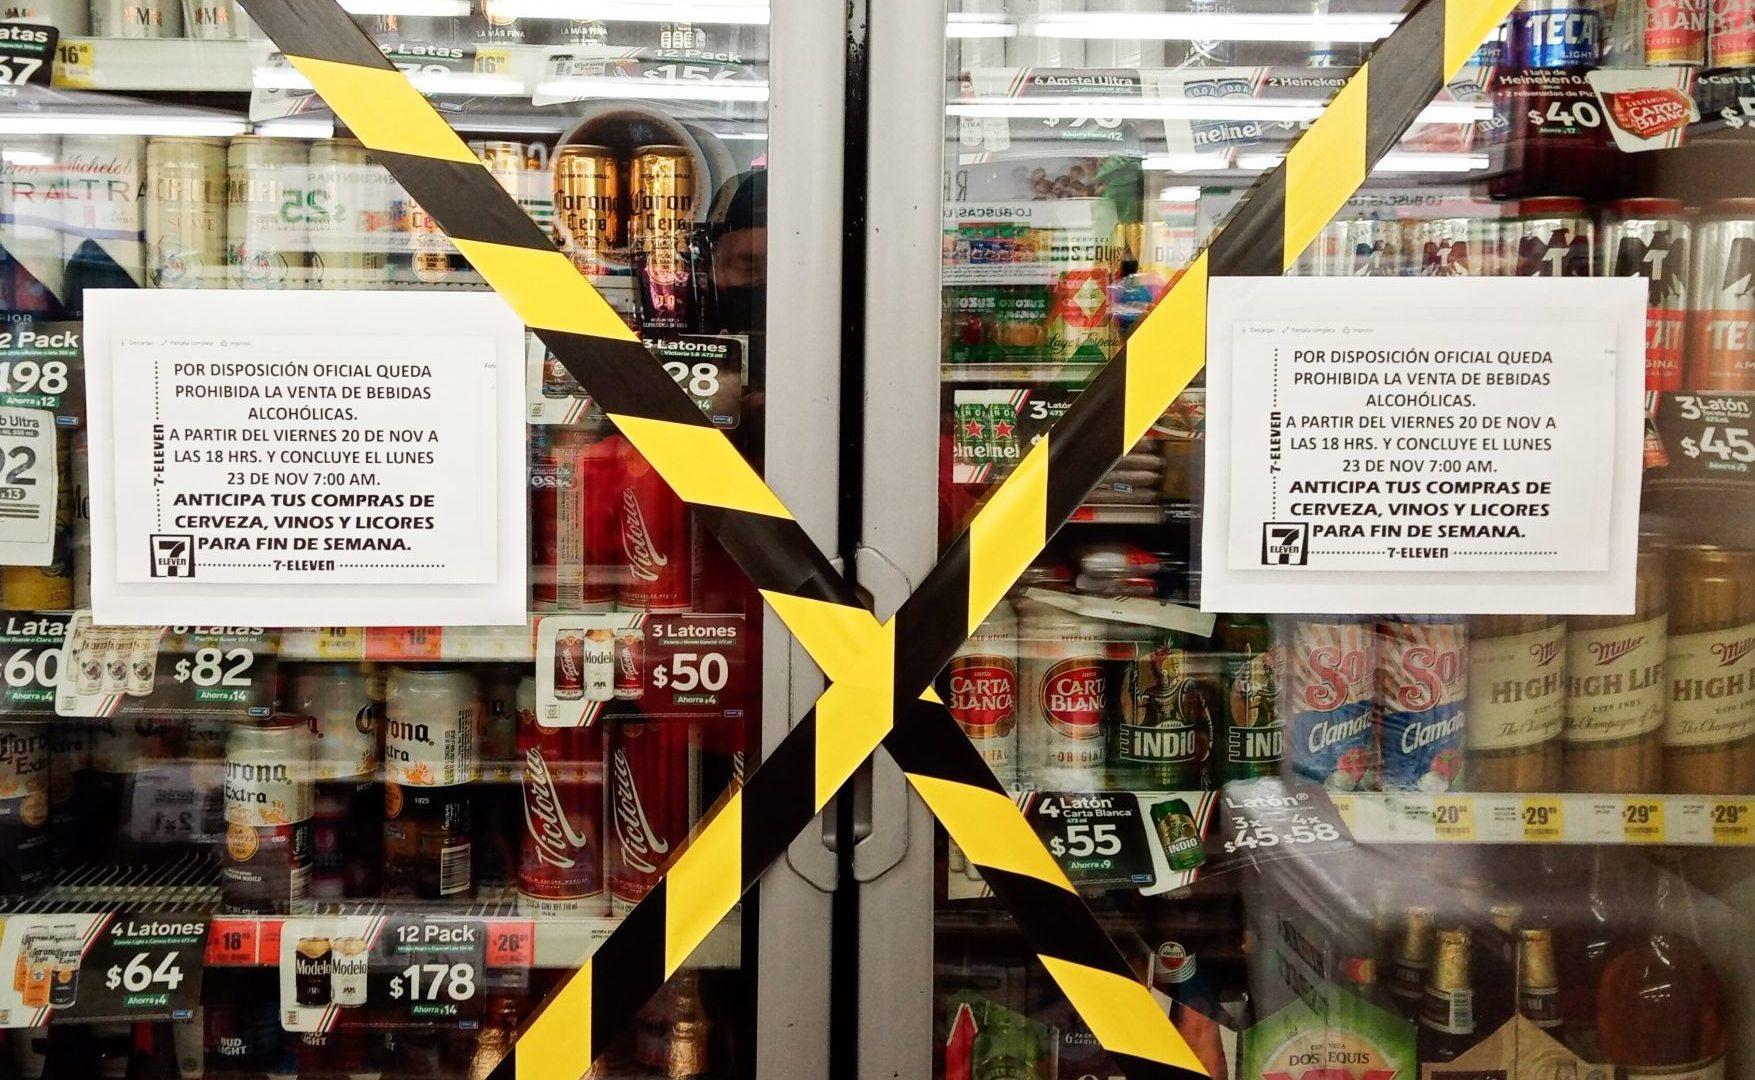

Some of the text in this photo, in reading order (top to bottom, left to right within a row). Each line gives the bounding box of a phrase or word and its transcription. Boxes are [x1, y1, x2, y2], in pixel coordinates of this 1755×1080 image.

[655, 49, 742, 62] 12 Pack
[1034, 76, 1133, 85] 6 Amstel Ultra
[1268, 78, 1345, 86] 2 Heineken
[1500, 75, 1569, 85] Heineken
[1527, 102, 1601, 128] $40
[18, 331, 79, 349] Pack
[643, 338, 727, 352] 3 Latones
[1295, 348, 1552, 364] POR DISPOSICIÓN OFICIAL QUEDA
[175, 362, 431, 378] POR DISPOSICIÓN OFICIAL QUEDA
[1295, 373, 1549, 385] PROHIBIDA LA VENTA DE BEBIDAS
[176, 386, 430, 399] PROHIBIDA LA VENTA DE BEBIDAS
[1367, 392, 1475, 407] ALCOHÓLICAS.
[7, 396, 36, 405] Ahorra
[249, 406, 357, 420] ALCOHÓLICAS.
[1675, 396, 1698, 420] 3
[10, 415, 40, 428] Ultra
[1286, 416, 1555, 428] A PARTIR DEL VIERNES 20 DE NOV A
[170, 429, 438, 442] A PARTIR DEL VIERNES 20 DE NOV A
[1292, 438, 1551, 450] LAS 18 HRS. Y CONCLUYE EL LUNES
[1681, 427, 1755, 463] $45
[175, 450, 433, 463] LAS 18 HRS. Y CONCLUYE EL LUNES
[1343, 460, 1497, 472] 23 DE NOV 7:00 AM.
[228, 473, 380, 485] 23 DE NOV 7:00 AM.
[1289, 481, 1550, 494] ANTICIPA TUS COMPRAS DE
[174, 494, 434, 507] ANTICIPA TUS COMPRAS DE
[1291, 503, 1549, 517] CERVEZA, VINOS Y LICORES
[175, 516, 434, 530] CERVEZA, VINOS Y LICORES
[620, 488, 667, 582] Victoria
[1313, 525, 1525, 537] PARA FIN DE SEMANA.
[199, 538, 411, 550] PARA FIN DE SEMANA.
[158, 558, 187, 566] ELEVEN
[652, 623, 736, 638] 3 Latones
[174, 648, 254, 686] $82
[653, 652, 729, 691] $50
[950, 676, 1010, 695] CARTA
[1673, 673, 1744, 701] HIGH
[200, 691, 228, 700] Ahorra
[677, 696, 703, 704] Ahorra
[950, 693, 1014, 711] BLANCA
[225, 780, 267, 803] Extra
[519, 745, 587, 868] Victoria
[612, 748, 669, 874] Victoria
[1039, 798, 1060, 818] 4
[1063, 809, 1131, 818] Carta Blanca
[1232, 814, 1320, 829] 3x 4x
[1050, 824, 1121, 858] $55
[1224, 823, 1340, 853] $45 $58
[1071, 861, 1099, 869] Ahorra
[111, 921, 204, 937] 4 Latones
[397, 925, 476, 942] 12 Pack
[105, 951, 184, 992] $64
[296, 958, 367, 976] Modelo Modelo
[389, 963, 476, 1001] $178
[127, 996, 154, 1005] Ahorra
[413, 1006, 439, 1014] Ahorra
[1289, 1052, 1370, 1066] DOS EQUIS
